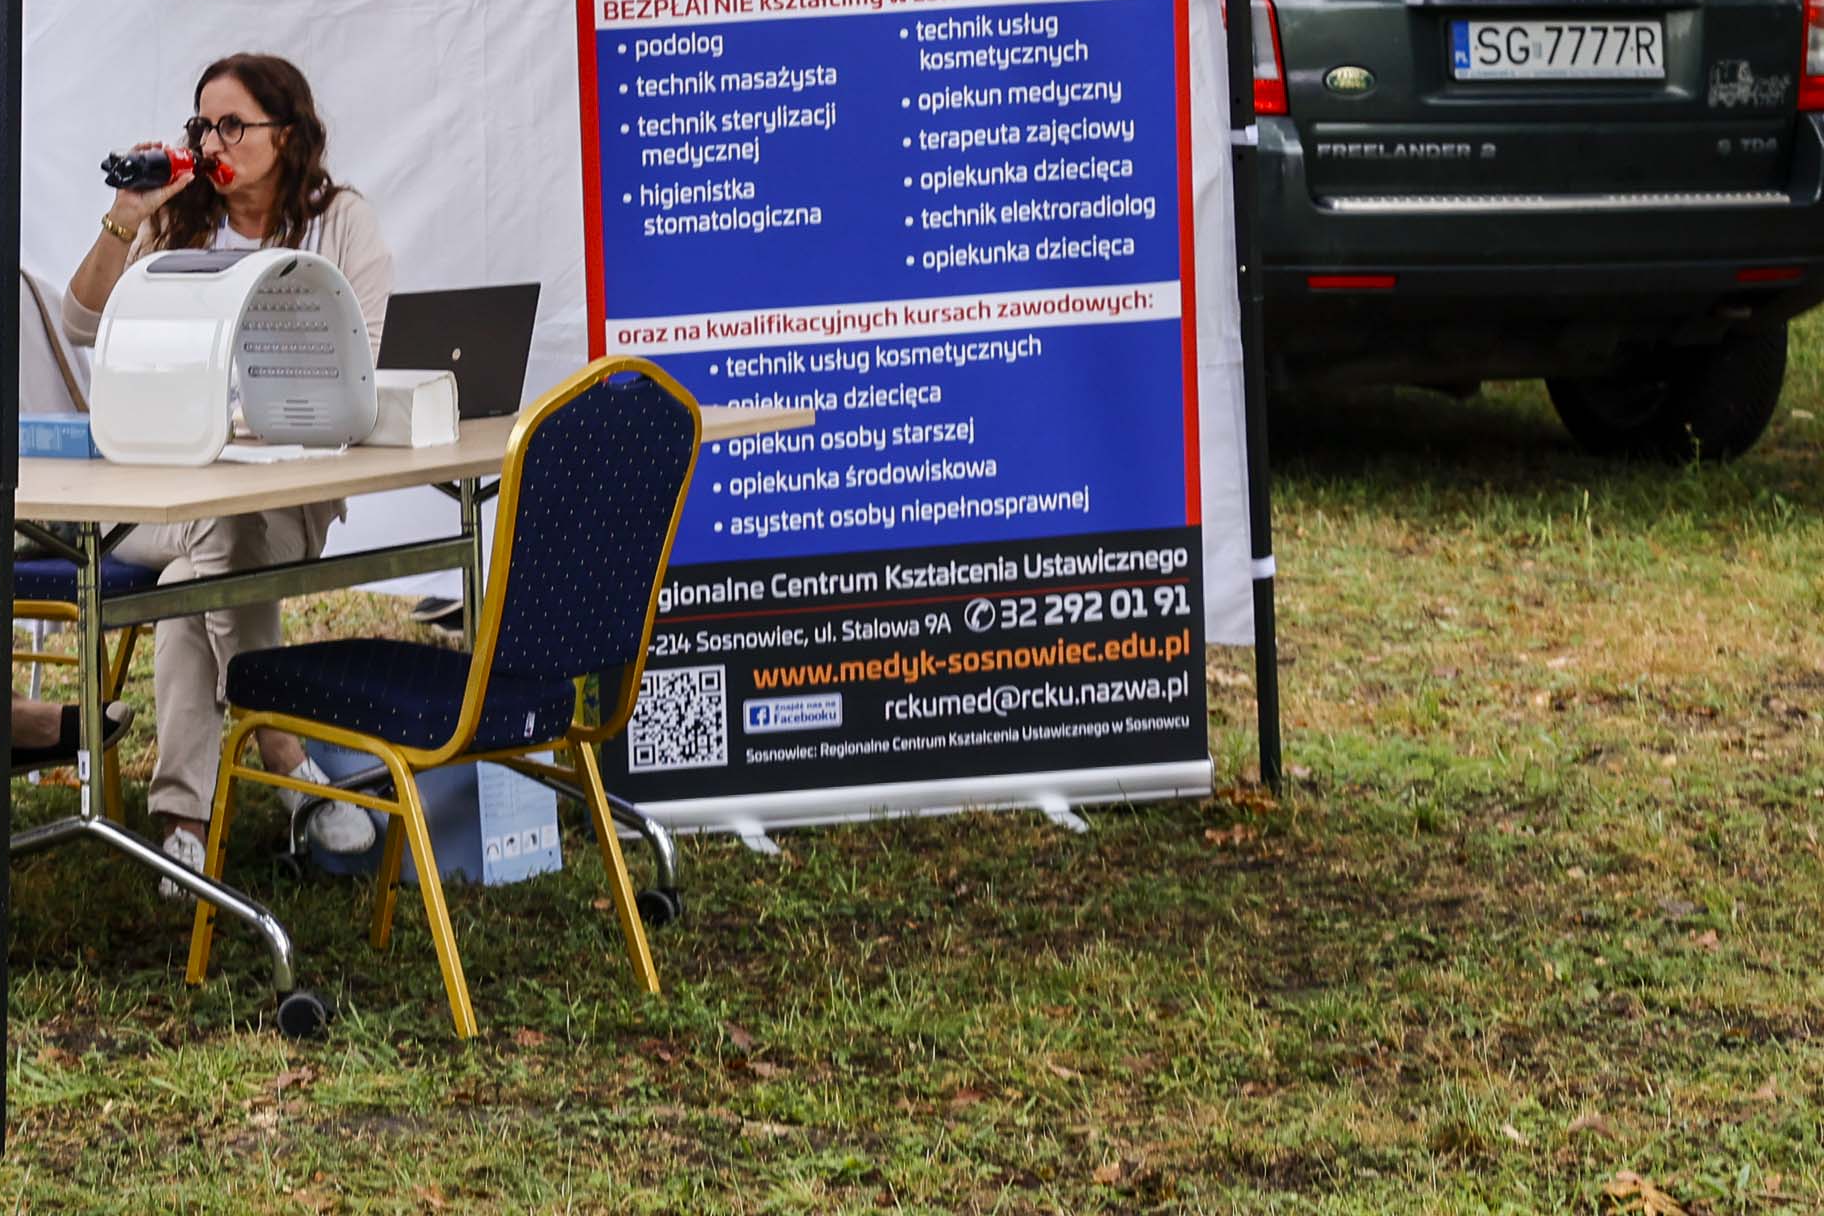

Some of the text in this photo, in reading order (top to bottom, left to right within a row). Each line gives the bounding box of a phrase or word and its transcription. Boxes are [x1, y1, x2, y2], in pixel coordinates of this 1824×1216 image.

[916, 12, 1059, 42] technik usług
[635, 32, 724, 62] podolog
[920, 39, 1088, 71] kosmetycznych
[1477, 26, 1656, 65] SG 7777R
[636, 64, 837, 97] technik masażysta
[918, 80, 1122, 115] opiekun medyczny
[637, 102, 836, 137] technik sterylizacji
[919, 117, 1135, 152] terapeuta zajęciowy
[642, 136, 761, 168] medycznej
[1317, 143, 1471, 160] FREELANDER
[920, 156, 1133, 194] opiekunka dziecięca
[640, 177, 755, 210] higienistka
[644, 204, 822, 236] stomatologiczna
[922, 194, 1156, 229] technik elektroradiolog
[922, 234, 1135, 272] opiekunka dziecięca
[618, 290, 1153, 344] oraz na kwalifikacyjnych kursach zawodowych:
[726, 334, 1041, 377] technik usług kosmetycznych
[844, 382, 941, 408] dziecięca
[728, 416, 975, 459] opiekun osoby starszej
[729, 458, 997, 499] opiekunka środowiskowa
[730, 484, 1089, 537] asystent osoby niepełnosprawnej
[657, 547, 1188, 613] gionalne Centrum Kształcenia Ustawicznego
[646, 584, 1191, 657] -214 Sosnowiec, ul. Stalowa 9A 32 292 01 91
[752, 627, 1190, 689] www.medyk-sosnowiec.edu.pl
[884, 670, 1189, 721] rckumed@rcku.nazwa.pl
[774, 710, 837, 726] Facebooku
[746, 740, 817, 764] Sosnowiec:
[820, 737, 890, 759] Regionalne
[893, 733, 946, 751] Centrum
[1022, 719, 1110, 742] Ustawicznego
[1112, 721, 1123, 733] w
[1125, 714, 1190, 732] Sosnowcu
